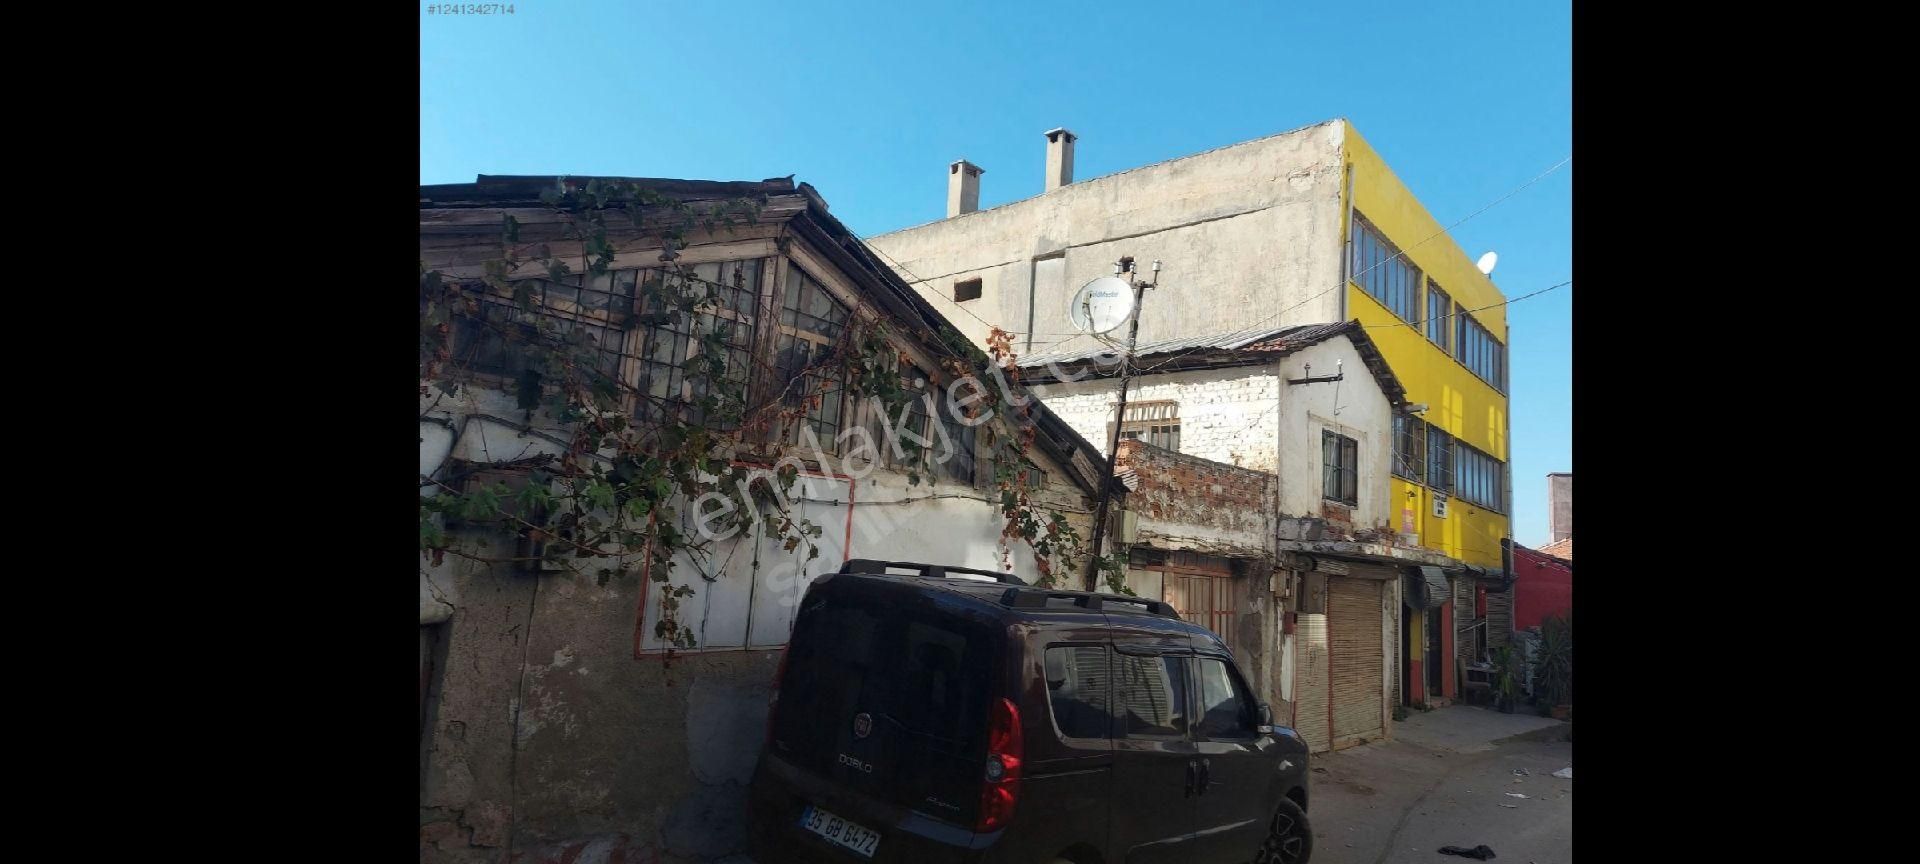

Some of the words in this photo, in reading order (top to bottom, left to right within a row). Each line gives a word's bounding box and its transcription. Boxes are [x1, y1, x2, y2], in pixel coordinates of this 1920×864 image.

[839, 753, 873, 773] DOBLO
[808, 809, 823, 829] 35
[826, 818, 843, 837] GB
[844, 825, 877, 853] 6472
